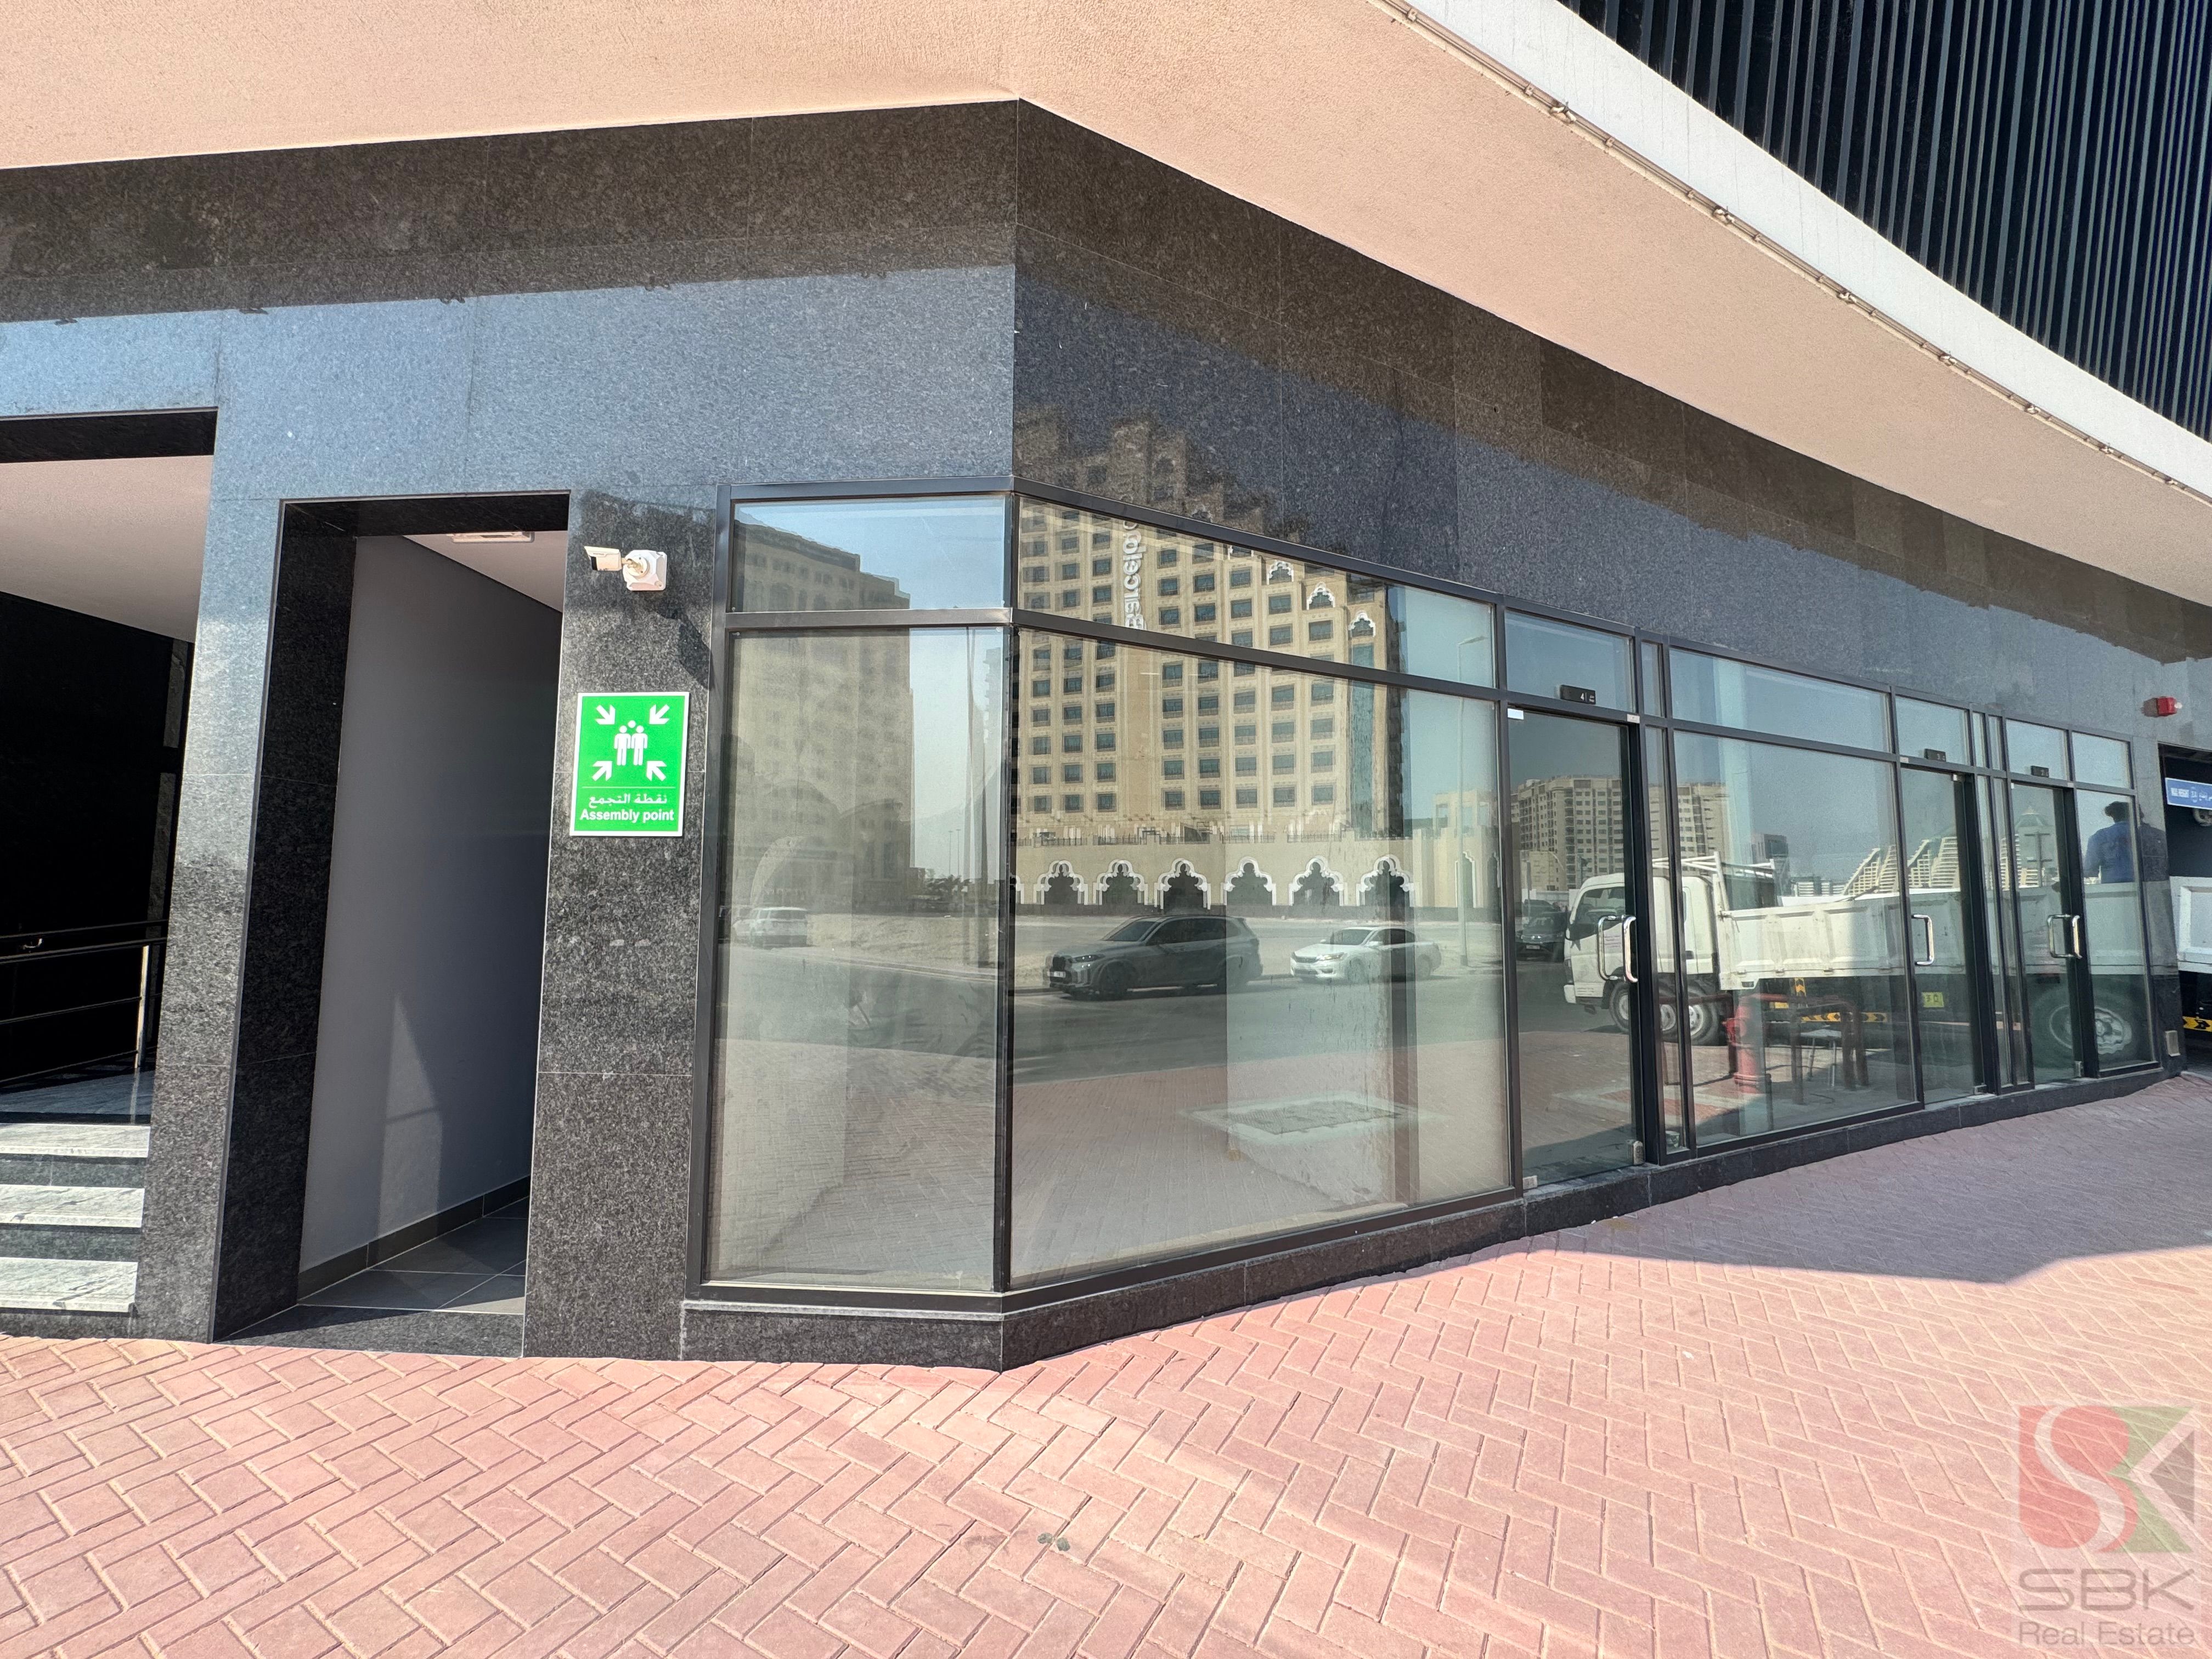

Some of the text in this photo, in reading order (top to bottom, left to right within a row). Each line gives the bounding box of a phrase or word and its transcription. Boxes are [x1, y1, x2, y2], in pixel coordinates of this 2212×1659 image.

[589, 793, 668, 809] نقطة التجمع
[579, 809, 675, 823] Assembly point
